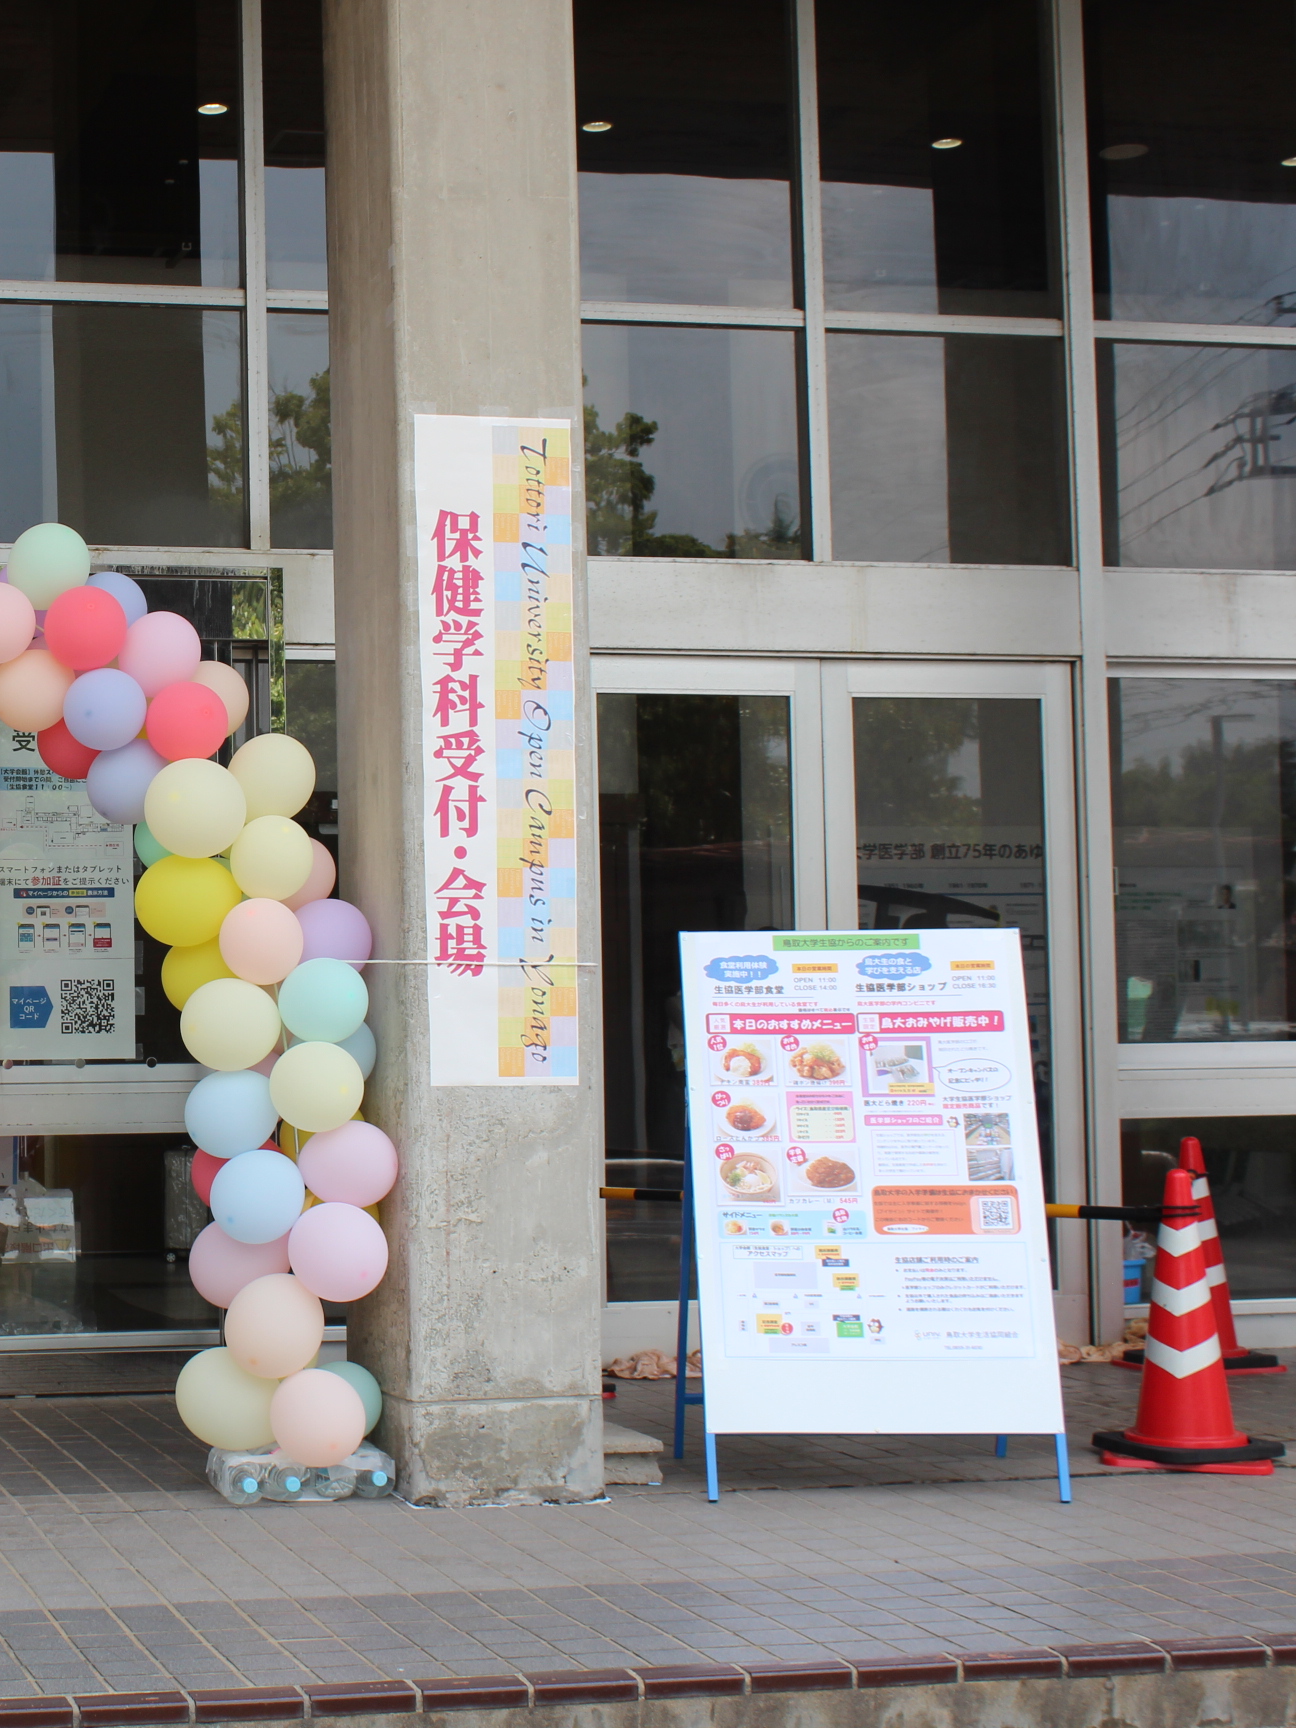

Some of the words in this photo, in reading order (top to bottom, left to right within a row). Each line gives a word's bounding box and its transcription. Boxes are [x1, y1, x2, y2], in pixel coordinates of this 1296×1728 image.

[520, 438, 547, 532] Tottori
[517, 541, 550, 690] University
[430, 509, 488, 977] 保健学科受付・会場
[518, 700, 552, 778] Open
[519, 788, 553, 906] Campus
[531, 918, 553, 943] in
[782, 937, 910, 948] 鳥取大学生協からのご案内です
[720, 962, 767, 970] 食堂利用体験
[865, 967, 921, 975] 学びを支える店
[714, 985, 785, 995] 生協医学部食堂
[855, 982, 947, 992] 生協医学部ショップ
[11, 997, 47, 1005] マイページ
[519, 954, 554, 1064] Yonago
[732, 1019, 852, 1030] 本日のおすすめメニュー
[881, 1015, 999, 1029] 鳥大おみやげ販売中！
[864, 1099, 904, 1107] 医大どら焼き
